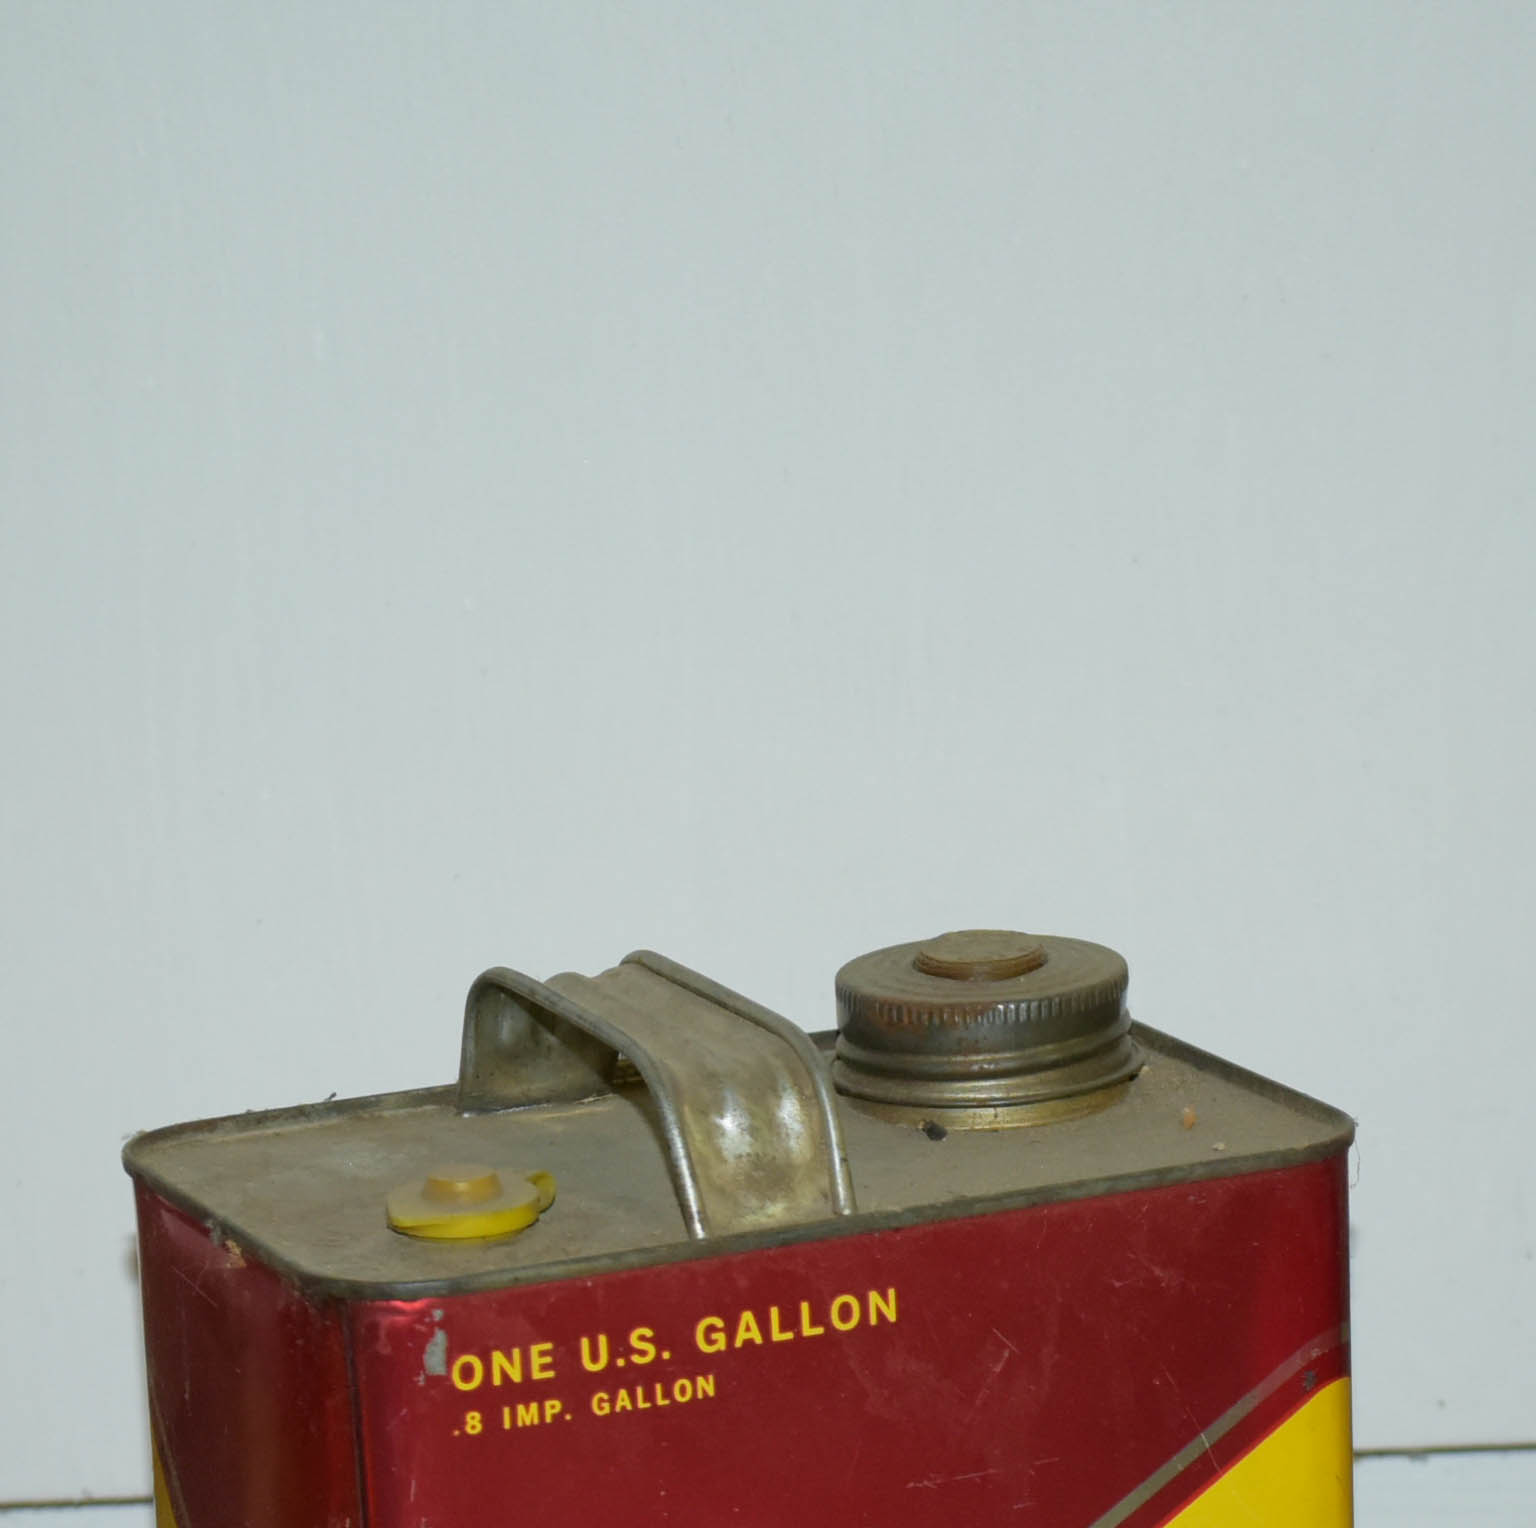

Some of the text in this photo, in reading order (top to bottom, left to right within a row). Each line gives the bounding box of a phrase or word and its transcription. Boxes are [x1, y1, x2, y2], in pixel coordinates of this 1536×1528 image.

[452, 1288, 898, 1391] ONE U.S. GALLON
[453, 1375, 716, 1436] .8 IMP. GALLON
